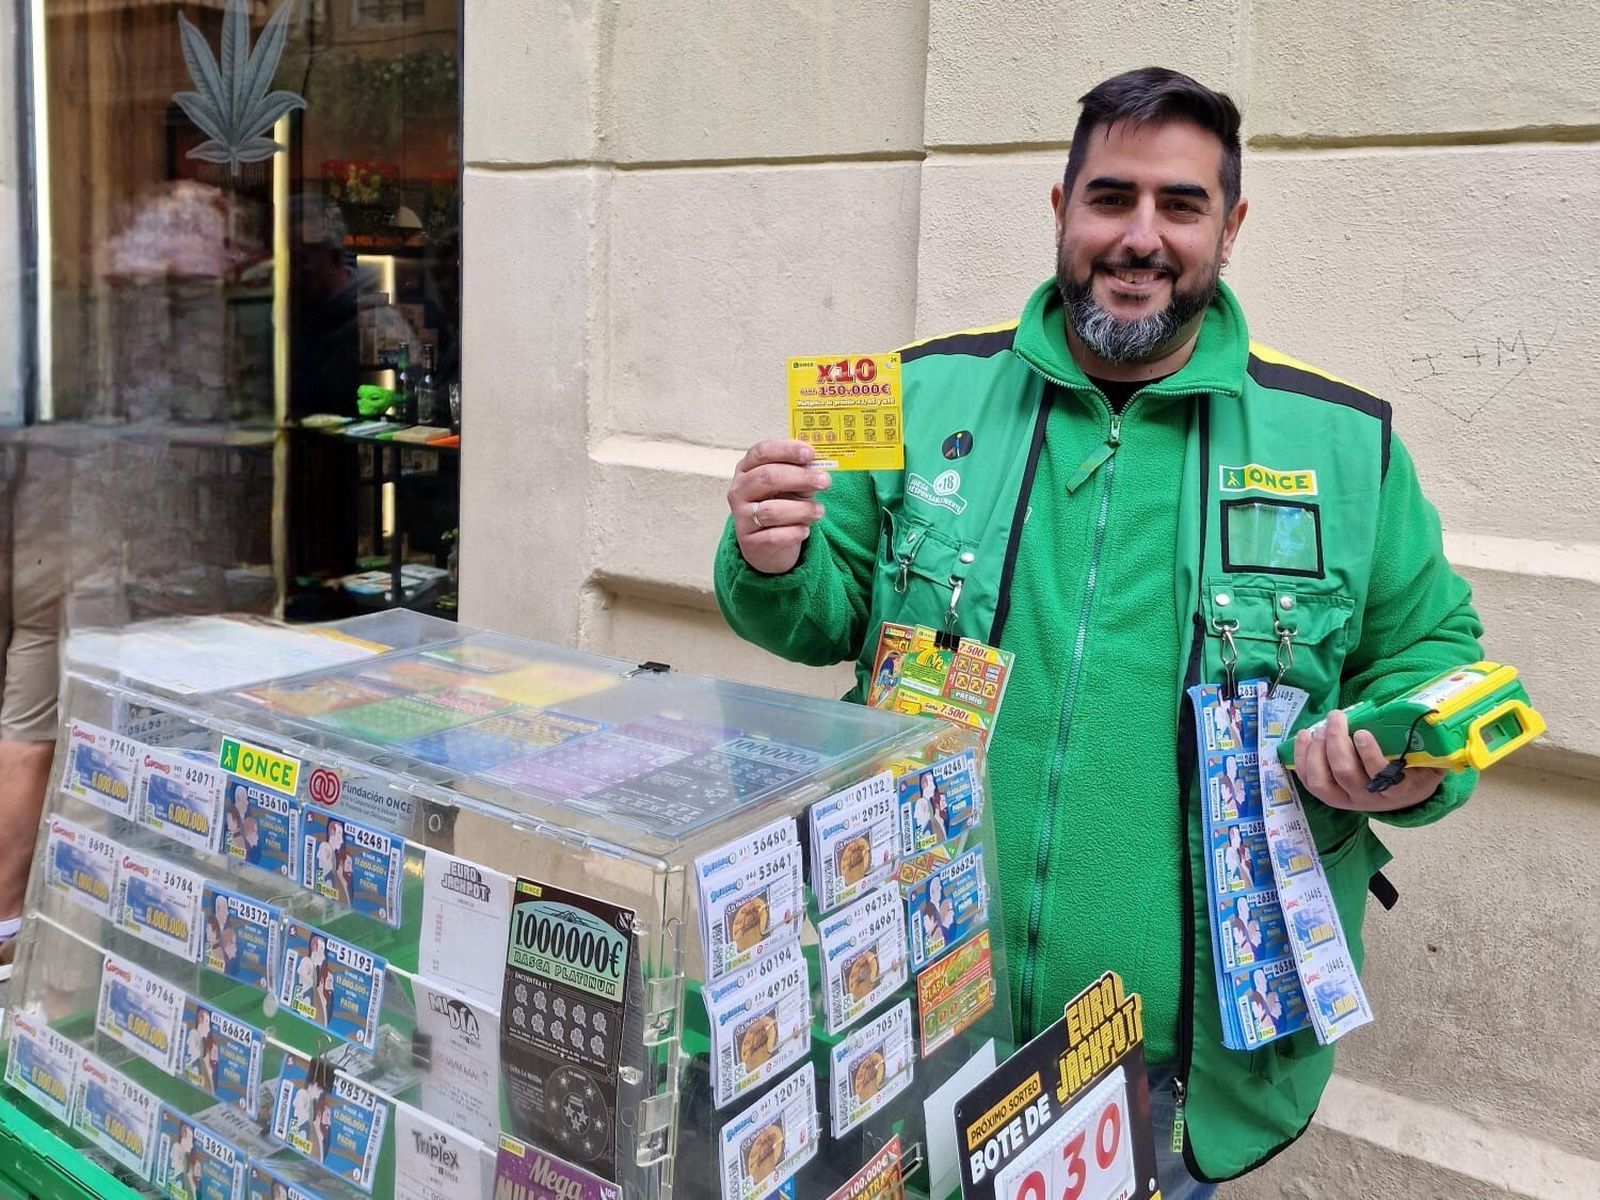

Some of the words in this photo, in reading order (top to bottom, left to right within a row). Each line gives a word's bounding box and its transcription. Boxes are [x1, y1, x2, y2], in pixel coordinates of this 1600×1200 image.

[817, 358, 877, 383] x10
[819, 384, 891, 397] 150.000€
[1249, 468, 1309, 490] ONCE
[109, 738, 135, 757] 97410
[186, 768, 214, 788] 62071
[242, 752, 293, 786] ONCE
[258, 793, 288, 812] 53610
[342, 782, 384, 804] Fundación
[387, 797, 413, 814] ONCE
[856, 780, 885, 802] 07122
[862, 800, 890, 823] 29753
[357, 830, 388, 853] 42481
[753, 828, 786, 855] 36480
[450, 861, 481, 882] EURO
[759, 853, 792, 881] 53641
[950, 856, 974, 877] 86624
[164, 872, 193, 894] 36784
[441, 873, 490, 902] JACKPOT
[239, 904, 268, 925] 28372
[865, 891, 893, 916] 94736
[869, 908, 896, 936] 84967
[338, 947, 372, 973] 51193
[760, 948, 792, 977] 60194
[513, 951, 550, 973] RASCA
[554, 965, 616, 996] PLATINUM
[768, 970, 799, 999] 49705
[145, 981, 174, 1005] 09766
[876, 1009, 903, 1036] 70519
[1067, 976, 1117, 1048] EURO
[222, 1021, 250, 1044] 86624
[1056, 1000, 1138, 1103] JACKPOT
[122, 1083, 149, 1108] 70349
[340, 1081, 374, 1107] 98575
[774, 1074, 806, 1106] 12078
[970, 1109, 1008, 1144] PRÓXIMO
[1008, 1080, 1040, 1118] SORTEO
[204, 1136, 234, 1165] 38216
[970, 1118, 1025, 1184] BOTE
[1025, 1094, 1051, 1138] DE
[529, 1156, 582, 1200] Mega
[850, 1154, 888, 1198] 100.000€
